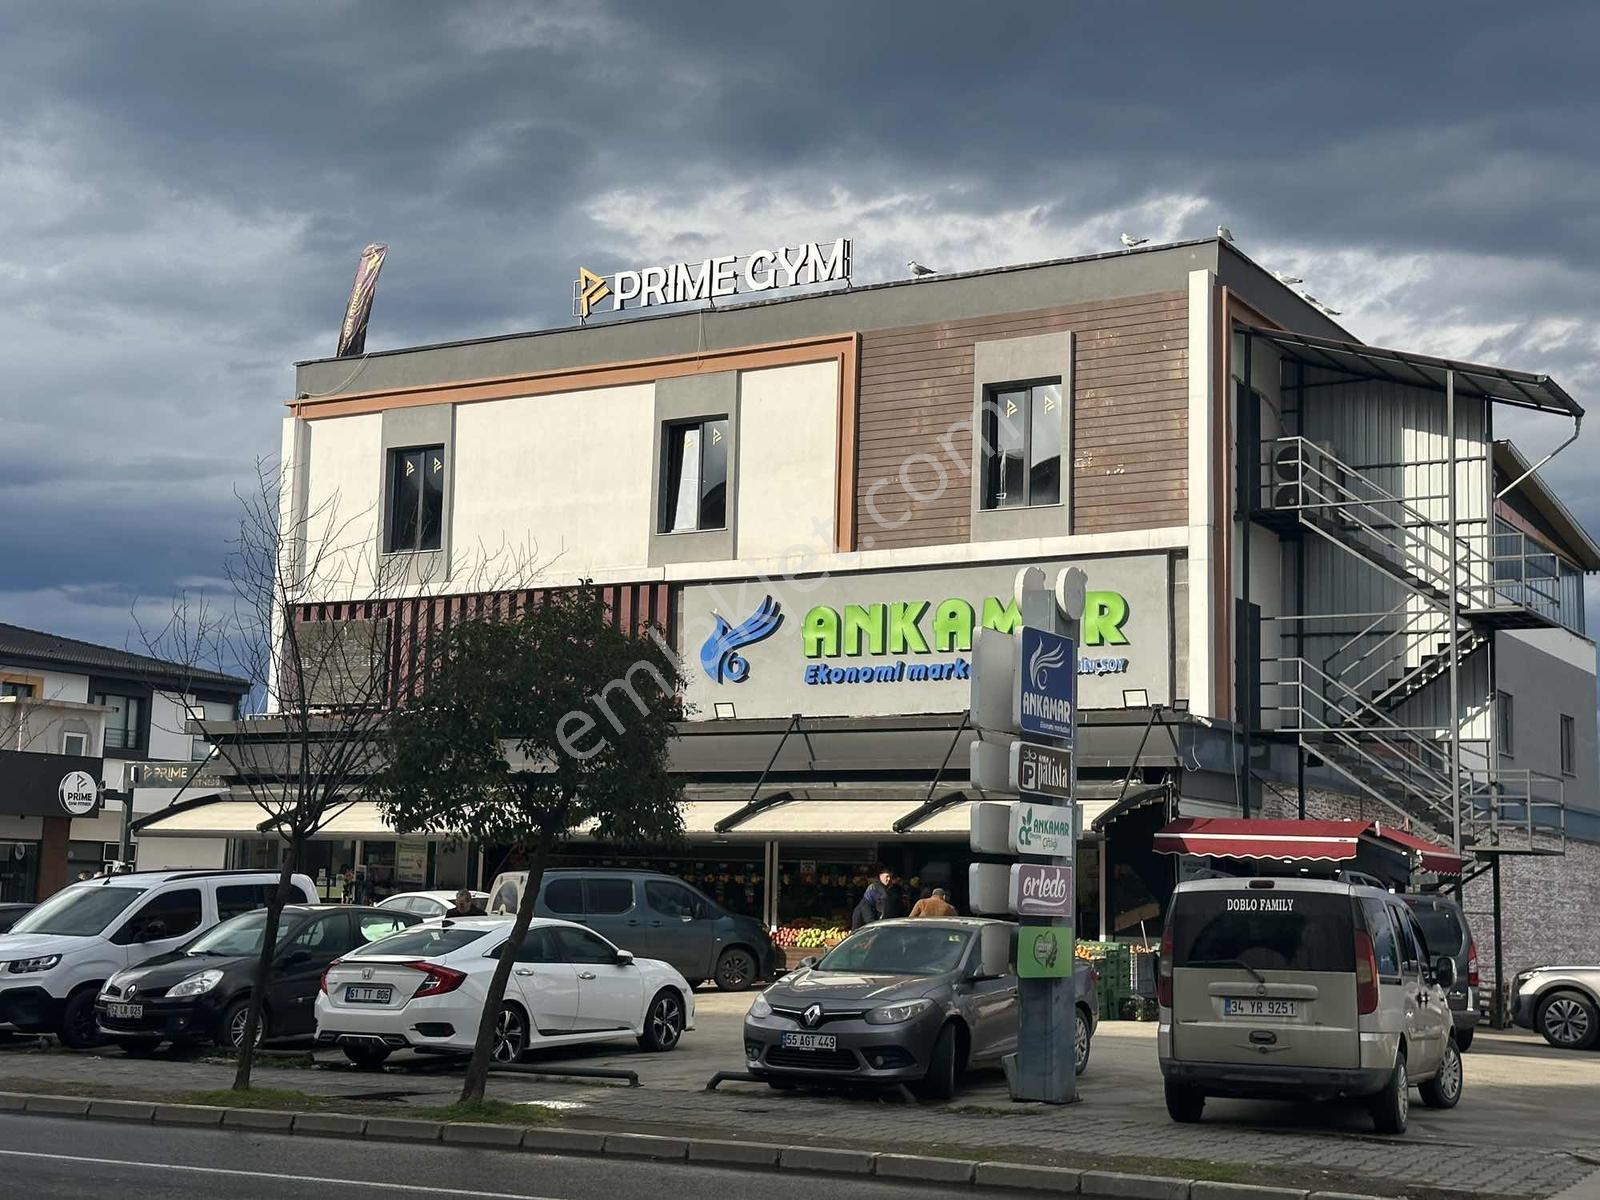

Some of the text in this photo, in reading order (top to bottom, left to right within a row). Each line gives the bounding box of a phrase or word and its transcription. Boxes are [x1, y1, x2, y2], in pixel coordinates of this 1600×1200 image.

[613, 238, 850, 310] PRIME GYM
[803, 660, 905, 686] Ekonomi
[906, 659, 973, 682] mark
[1023, 692, 1070, 724] ANKAMAR
[154, 767, 188, 781] PRIME
[67, 792, 92, 801] PRIME
[1033, 819, 1070, 837] ANKAMAR
[1023, 868, 1066, 898] orledo
[1227, 898, 1294, 911] DOBLO FAMILY
[364, 989, 373, 999] TT
[1231, 1001, 1294, 1014] 34 YR 9251
[786, 1034, 835, 1048] 55 AGT 449
